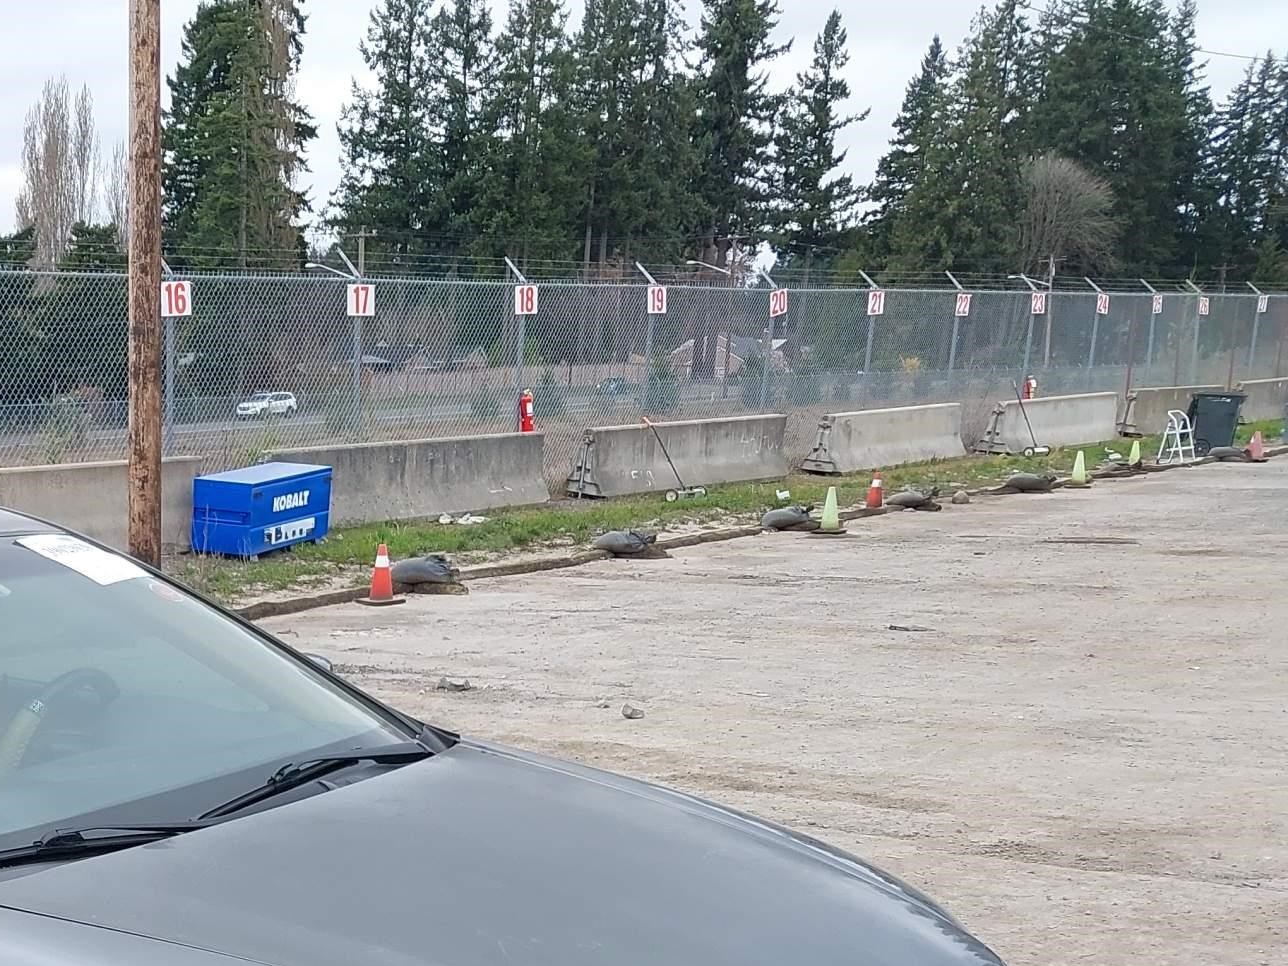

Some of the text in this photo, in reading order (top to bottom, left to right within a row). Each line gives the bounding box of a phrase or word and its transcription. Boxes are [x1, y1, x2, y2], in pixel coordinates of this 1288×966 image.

[165, 283, 186, 314] 16
[353, 286, 369, 313] 17
[519, 287, 533, 312] 18
[651, 288, 663, 311] 19
[772, 291, 785, 314] 20
[870, 293, 882, 313] 21
[957, 295, 969, 314] 22
[1033, 295, 1043, 312] 23
[1098, 295, 1107, 312] 24
[272, 490, 310, 512] KOBALT
